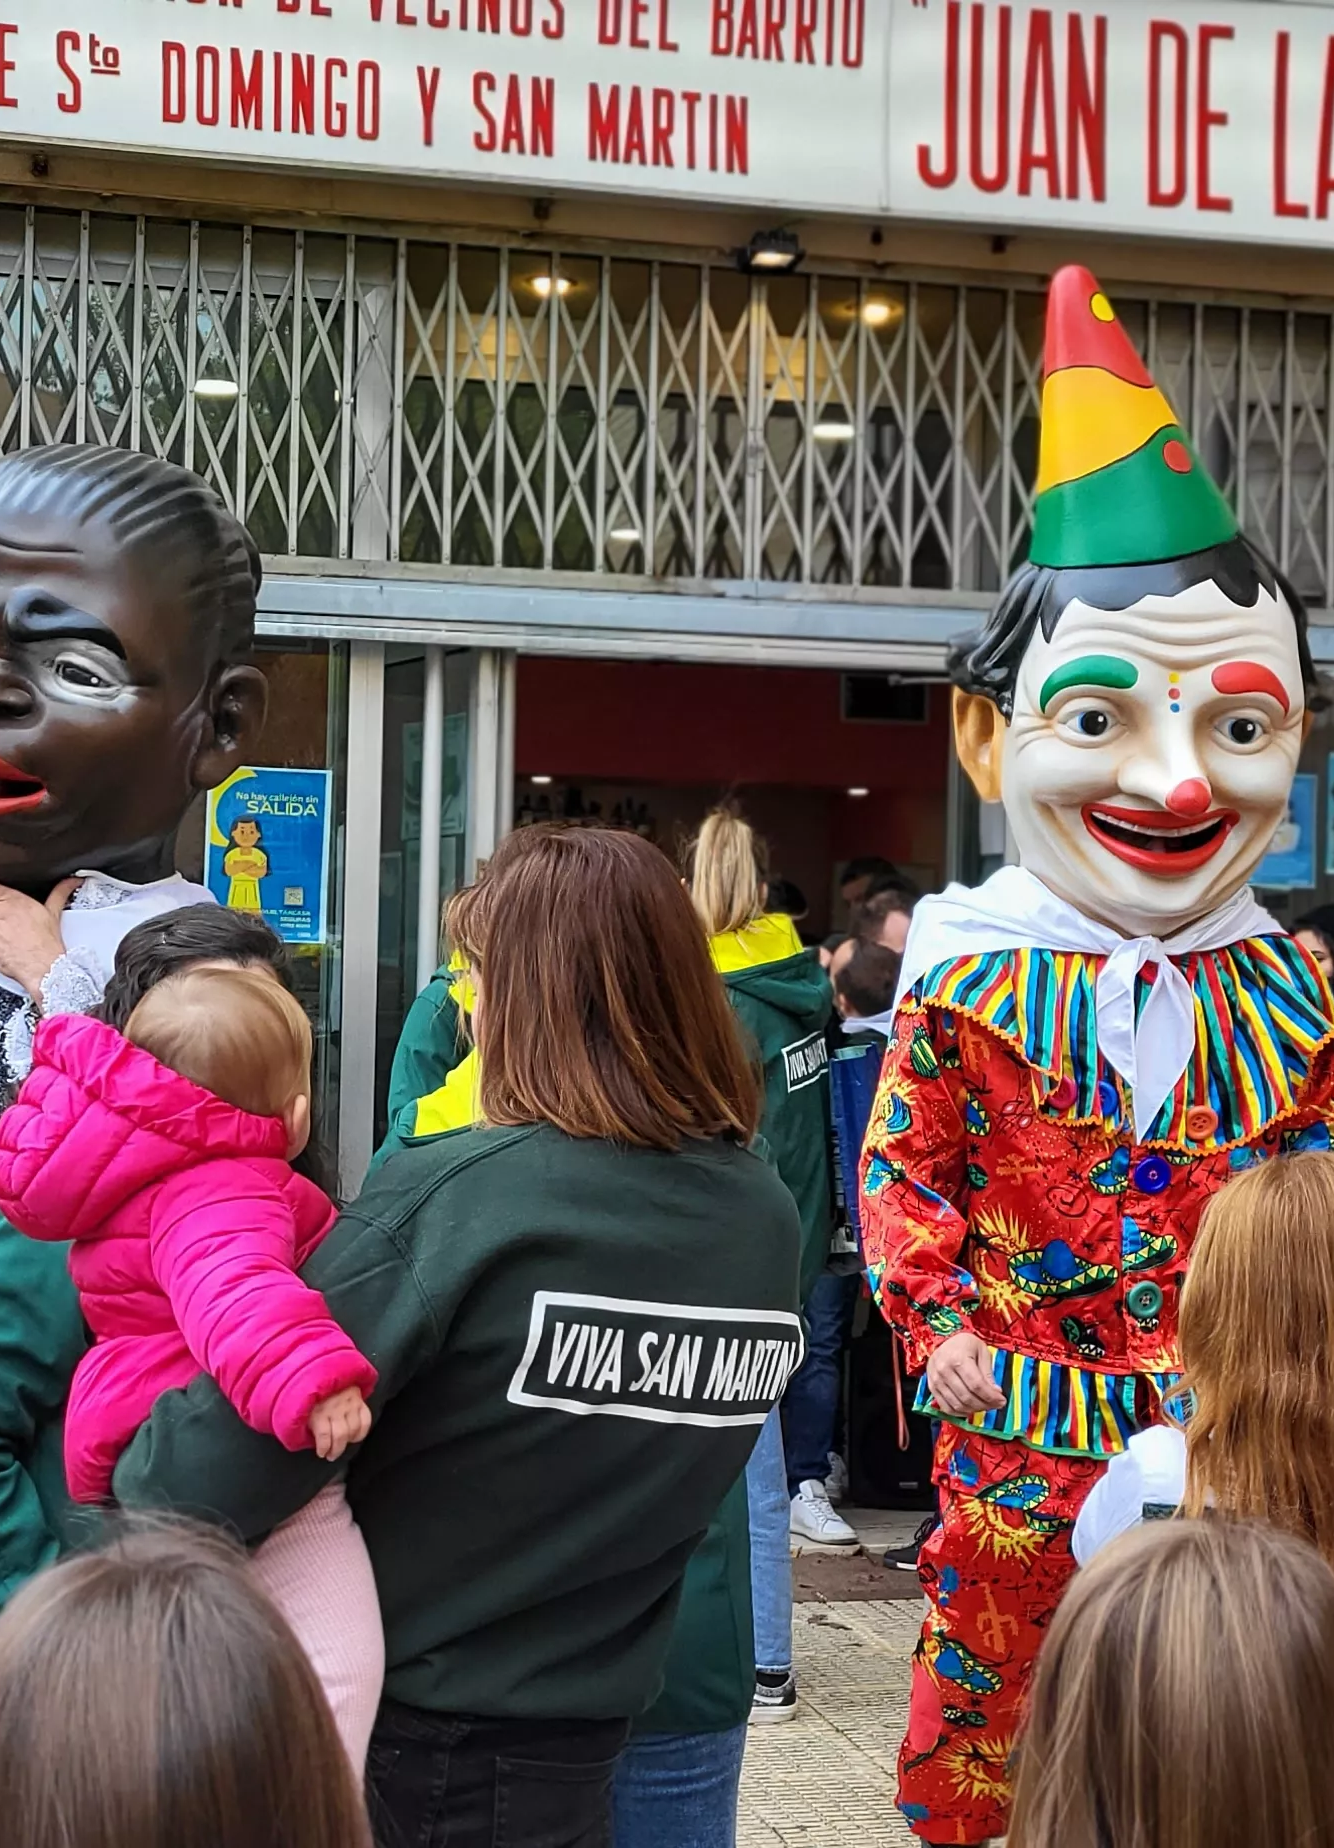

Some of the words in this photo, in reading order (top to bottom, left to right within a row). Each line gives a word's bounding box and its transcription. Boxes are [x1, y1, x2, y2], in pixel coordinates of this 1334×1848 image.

[710, 0, 865, 68] BARRIO
[161, 40, 381, 141] DOMINGO
[416, 66, 441, 147] Y
[472, 70, 555, 157] SAN
[587, 82, 749, 175] MARTIN
[1146, 19, 1235, 212] DE
[235, 791, 250, 801] No
[250, 791, 268, 804] hay
[305, 794, 319, 805] sin
[246, 800, 318, 817] SALIDA
[546, 1321, 625, 1394] VIVA
[629, 1331, 704, 1400] SAN
[702, 1337, 797, 1402] MARTIN
